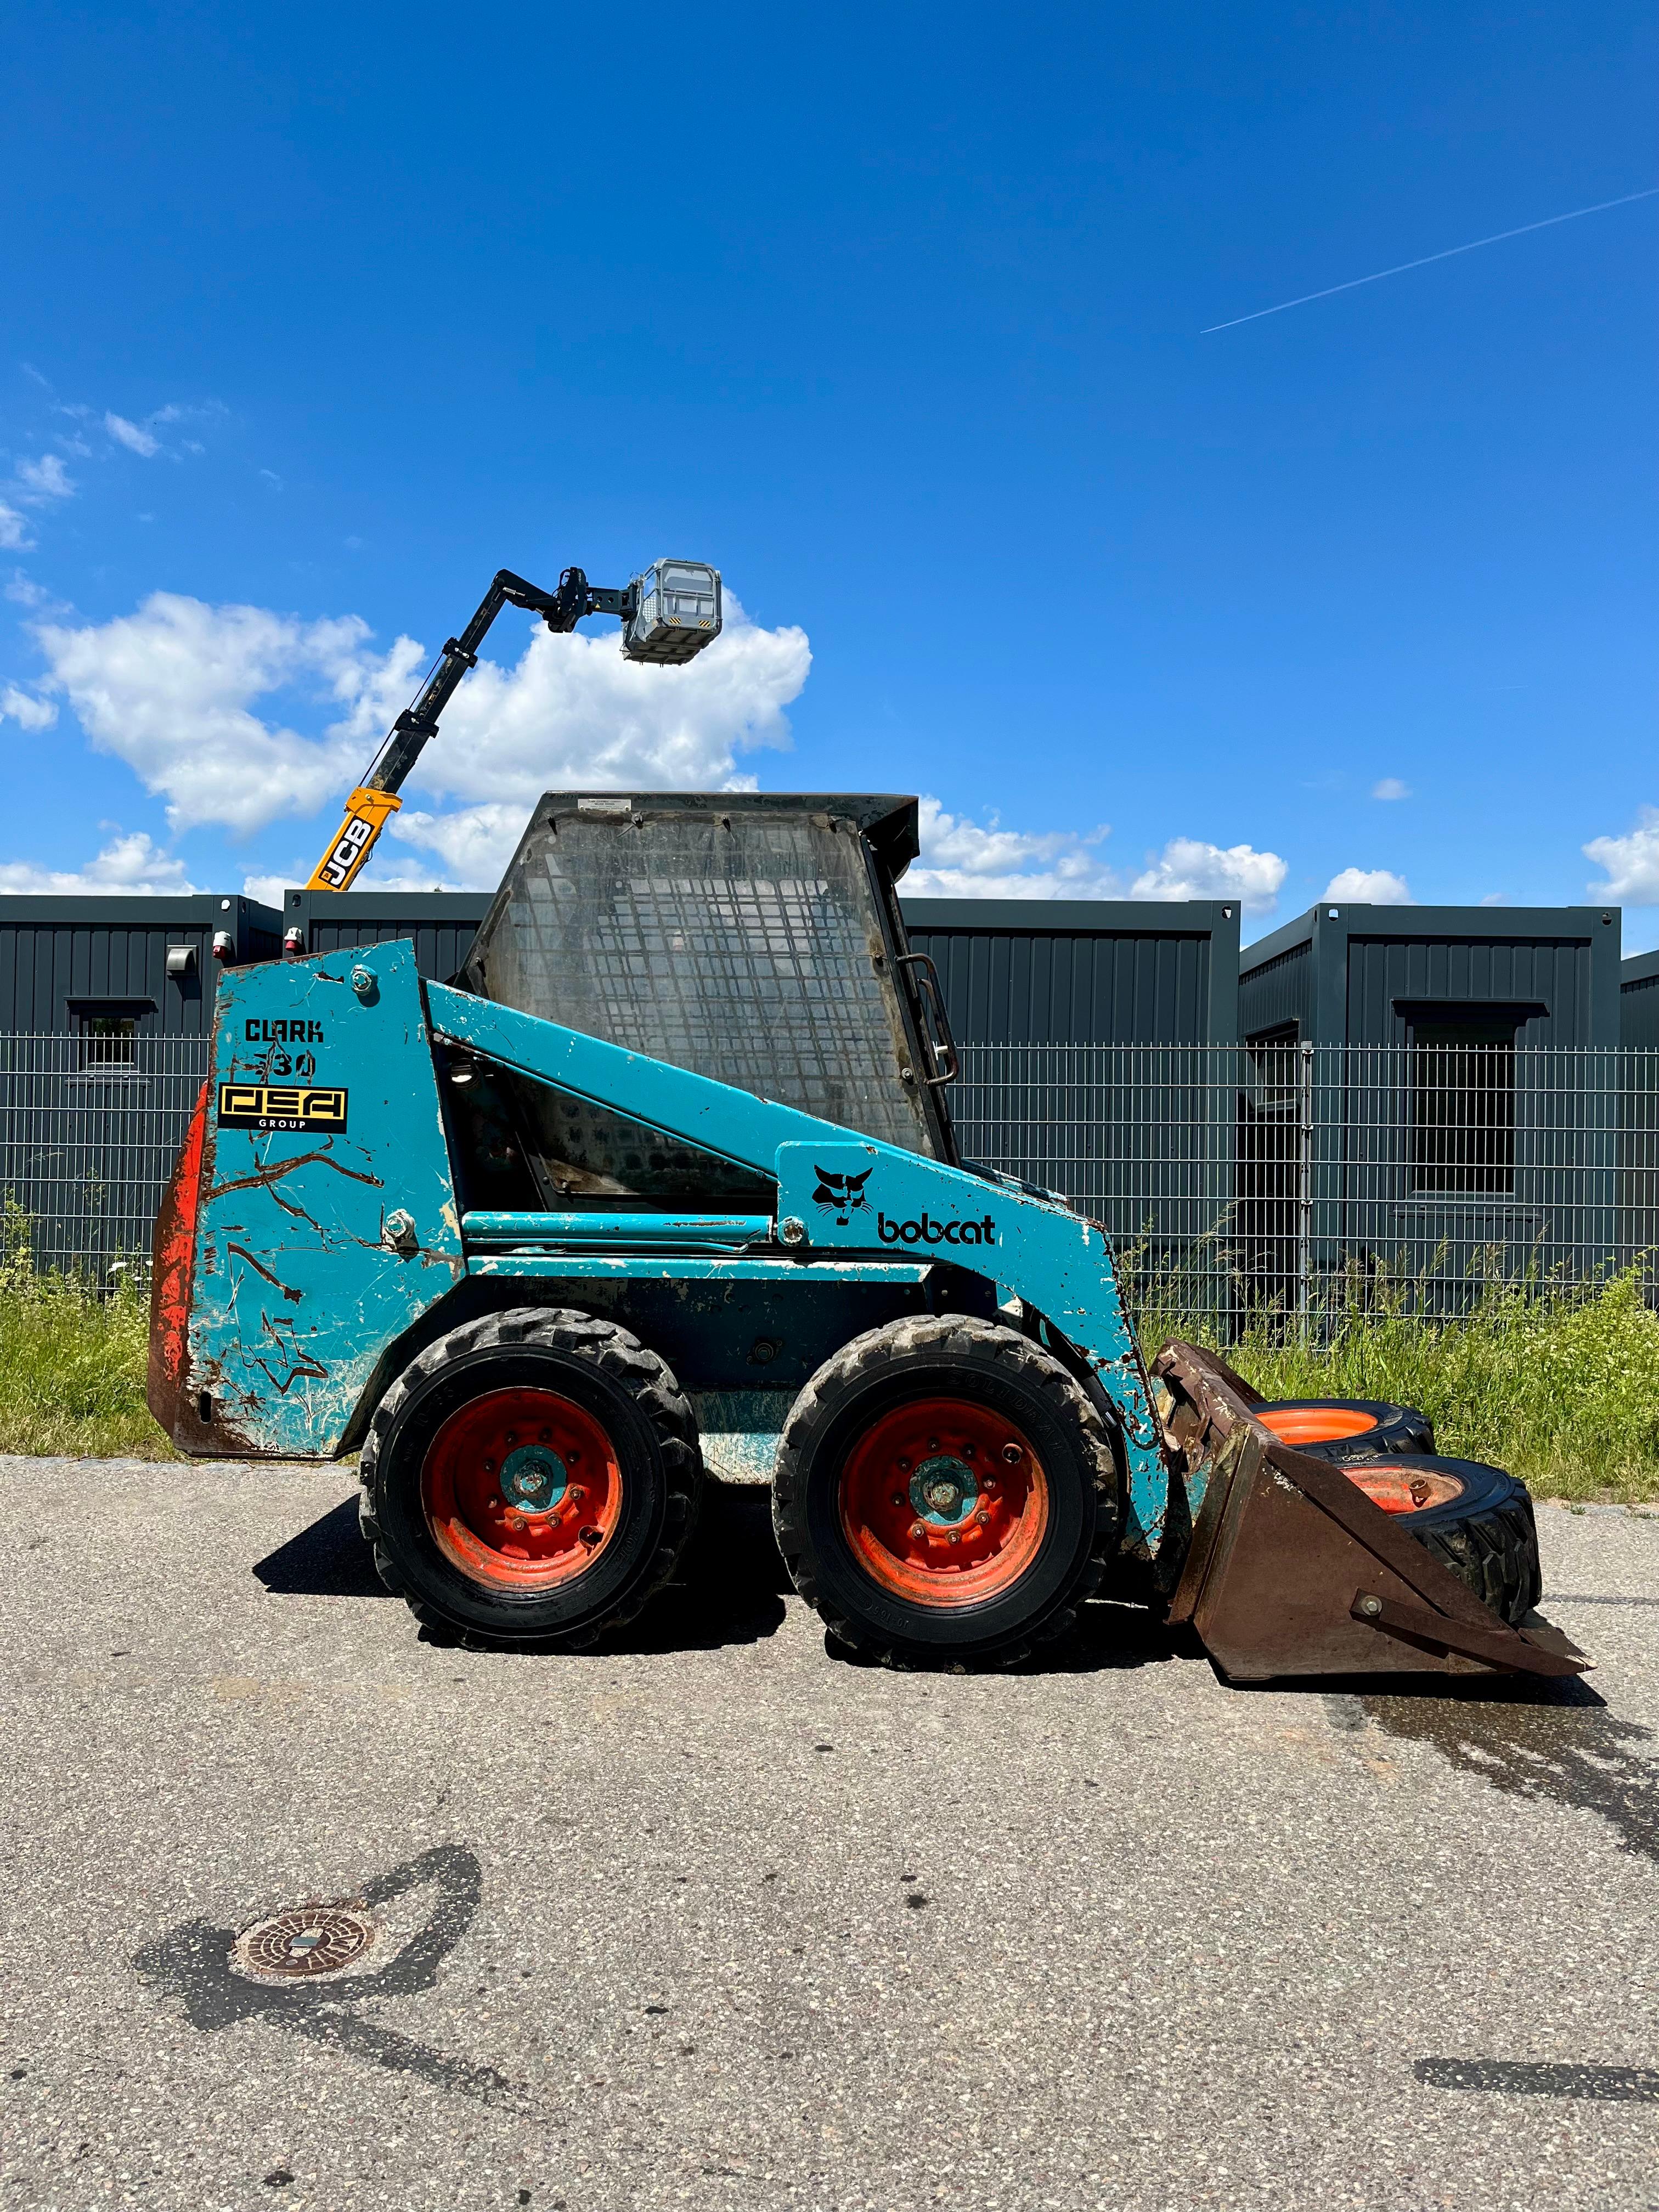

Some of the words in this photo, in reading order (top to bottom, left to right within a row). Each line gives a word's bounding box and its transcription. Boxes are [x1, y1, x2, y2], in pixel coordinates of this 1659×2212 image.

[328, 819, 371, 885] JCB
[246, 1019, 324, 1043] CLARK
[259, 1119, 306, 1128] GROUP
[878, 1212, 996, 1245] bobcat
[947, 1370, 1064, 1451] SOLIDEAL
